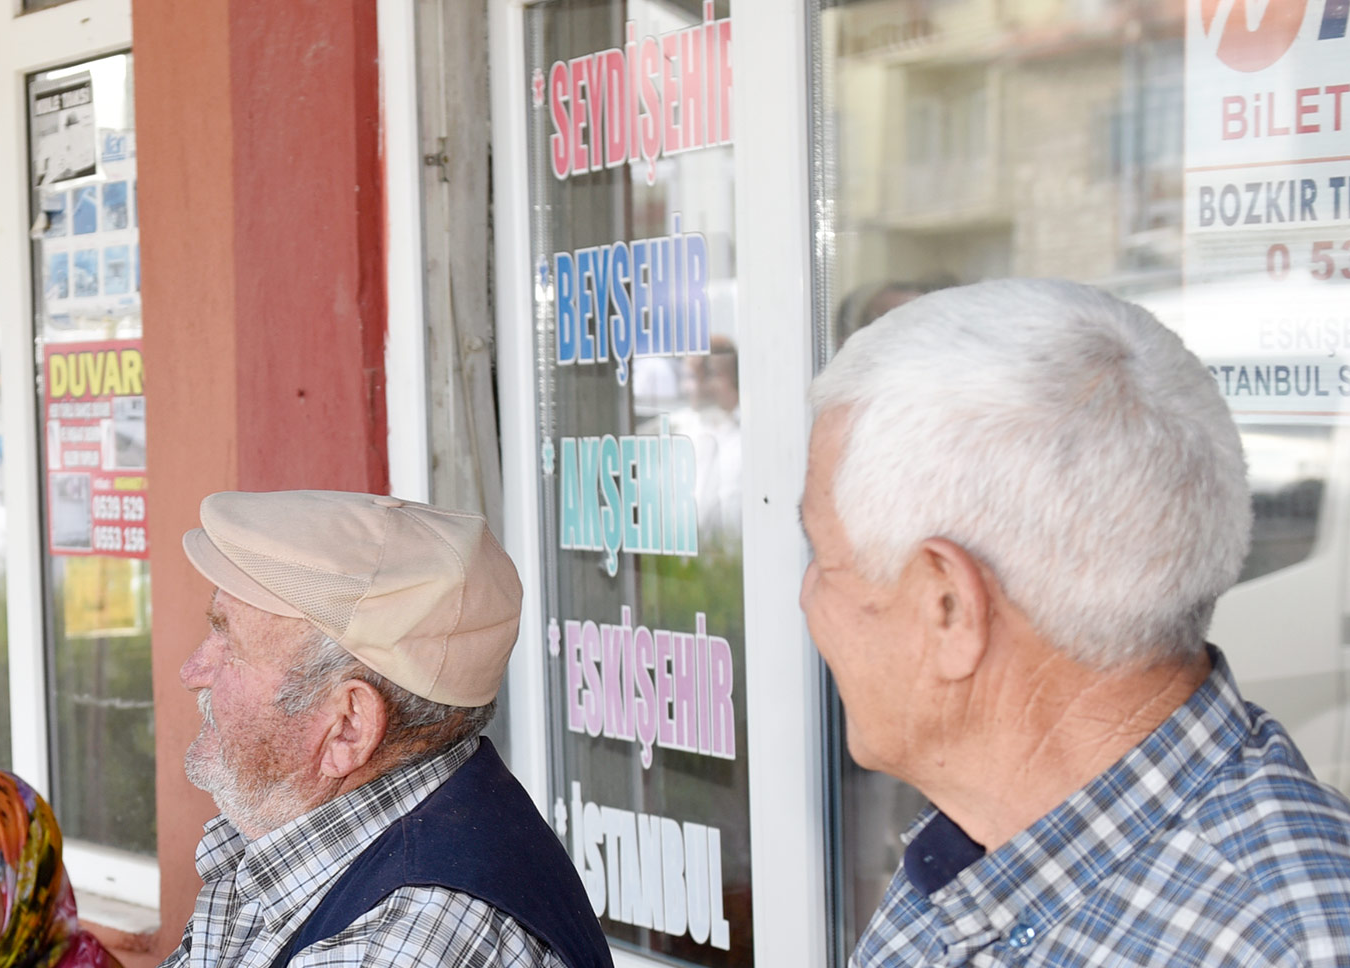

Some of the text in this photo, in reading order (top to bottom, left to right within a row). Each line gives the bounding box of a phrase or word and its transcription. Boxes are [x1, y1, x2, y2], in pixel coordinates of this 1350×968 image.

[1199, 176, 1350, 227] BOZKIR T
[49, 348, 144, 399] DUVAR
[554, 212, 711, 386] BEYŞEHİR
[561, 412, 699, 577] AKŞEHİR
[564, 605, 736, 769] ESKİŞEHİR
[571, 780, 731, 951] İSTANBUL
